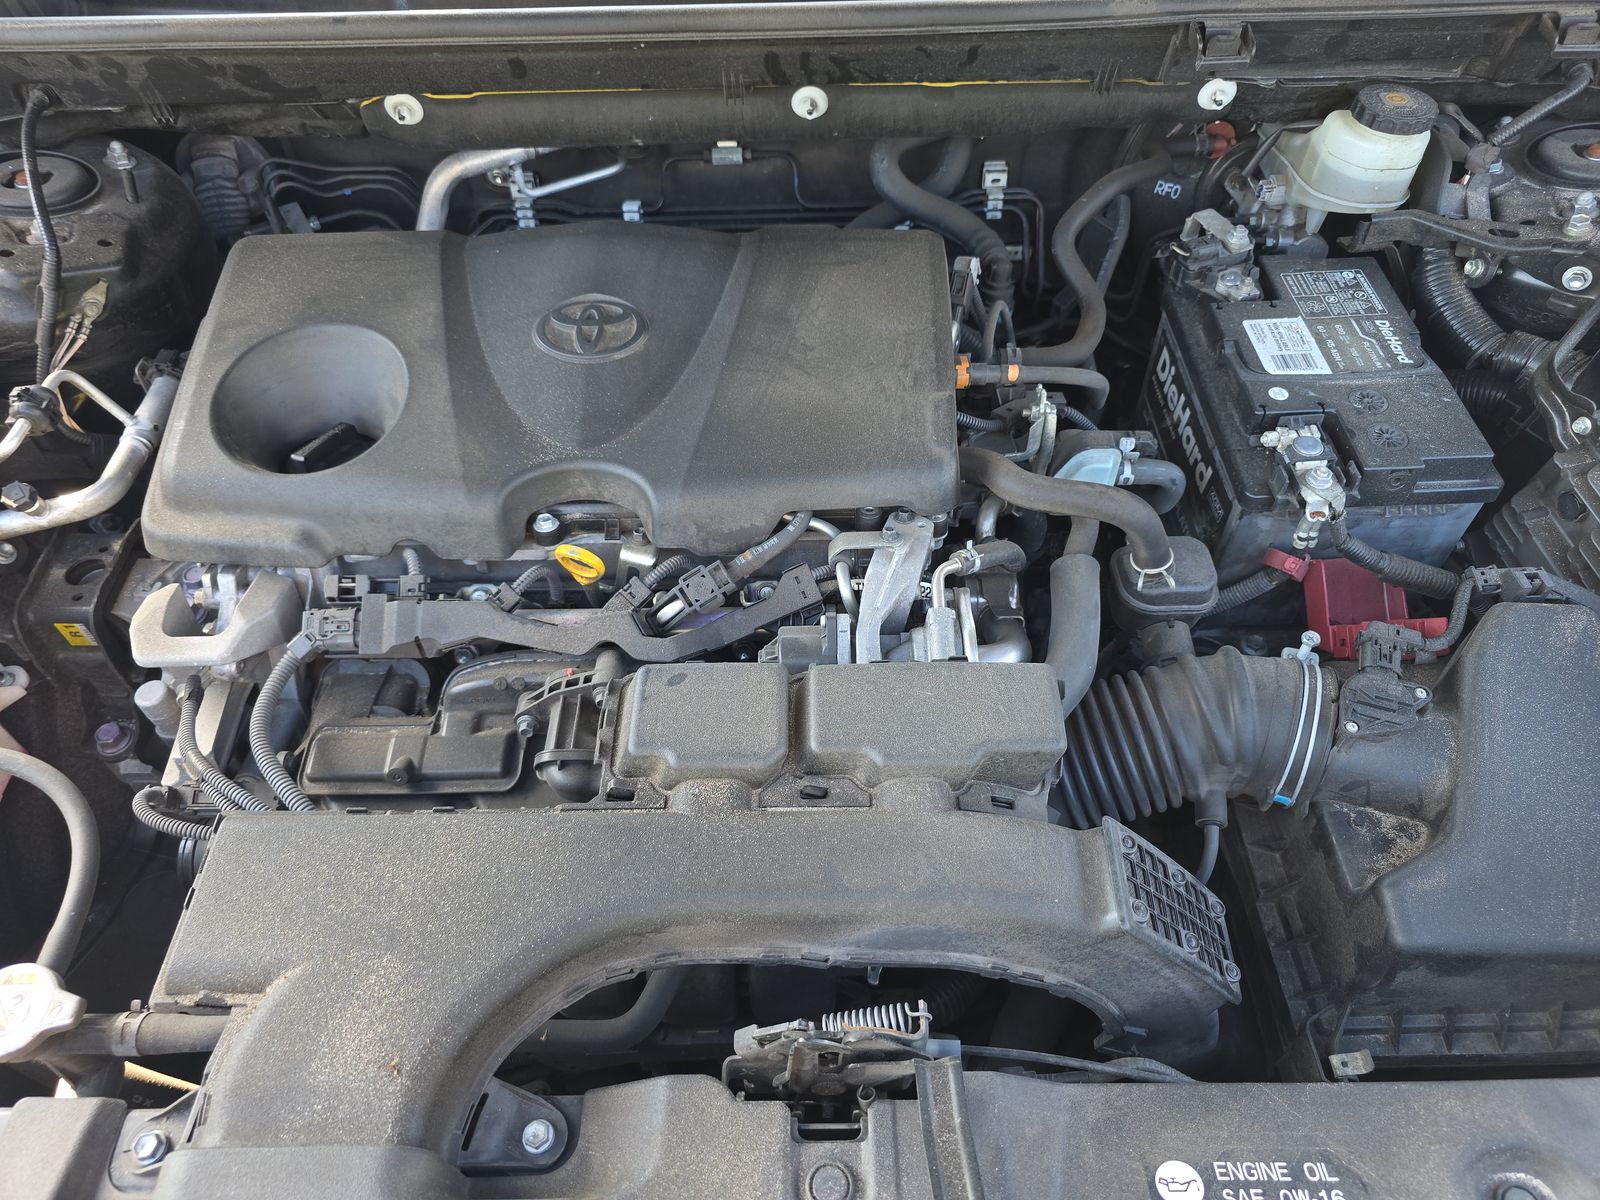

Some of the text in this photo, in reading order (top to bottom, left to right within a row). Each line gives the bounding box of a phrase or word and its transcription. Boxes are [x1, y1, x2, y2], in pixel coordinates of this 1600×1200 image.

[1374, 320, 1414, 364] DieHard
[1156, 346, 1213, 495] DieHard
[1213, 1161, 1340, 1181] ENGINE OIL
[1222, 1188, 1265, 1200] SAE
